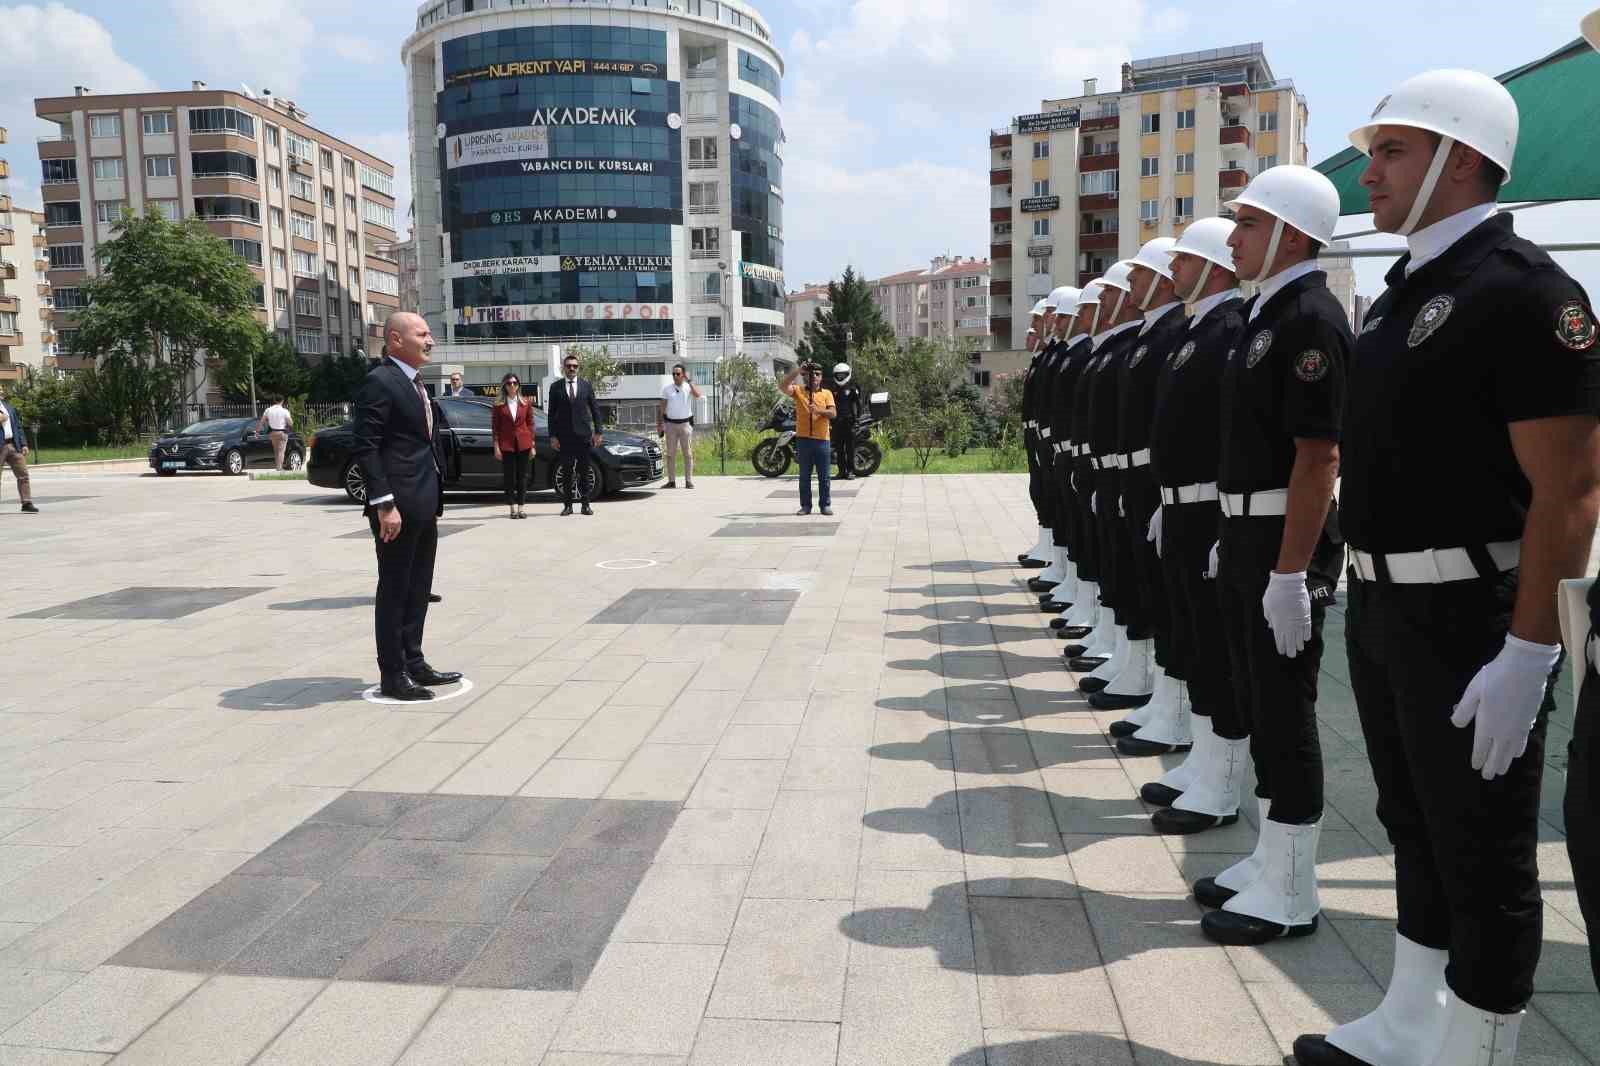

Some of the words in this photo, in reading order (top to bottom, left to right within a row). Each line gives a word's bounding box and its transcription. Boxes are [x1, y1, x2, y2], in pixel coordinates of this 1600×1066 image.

[489, 60, 552, 78] NURKENT
[520, 160, 572, 171] YABANCI
[599, 160, 653, 172] KURSLARI
[627, 256, 672, 266] HUKUK
